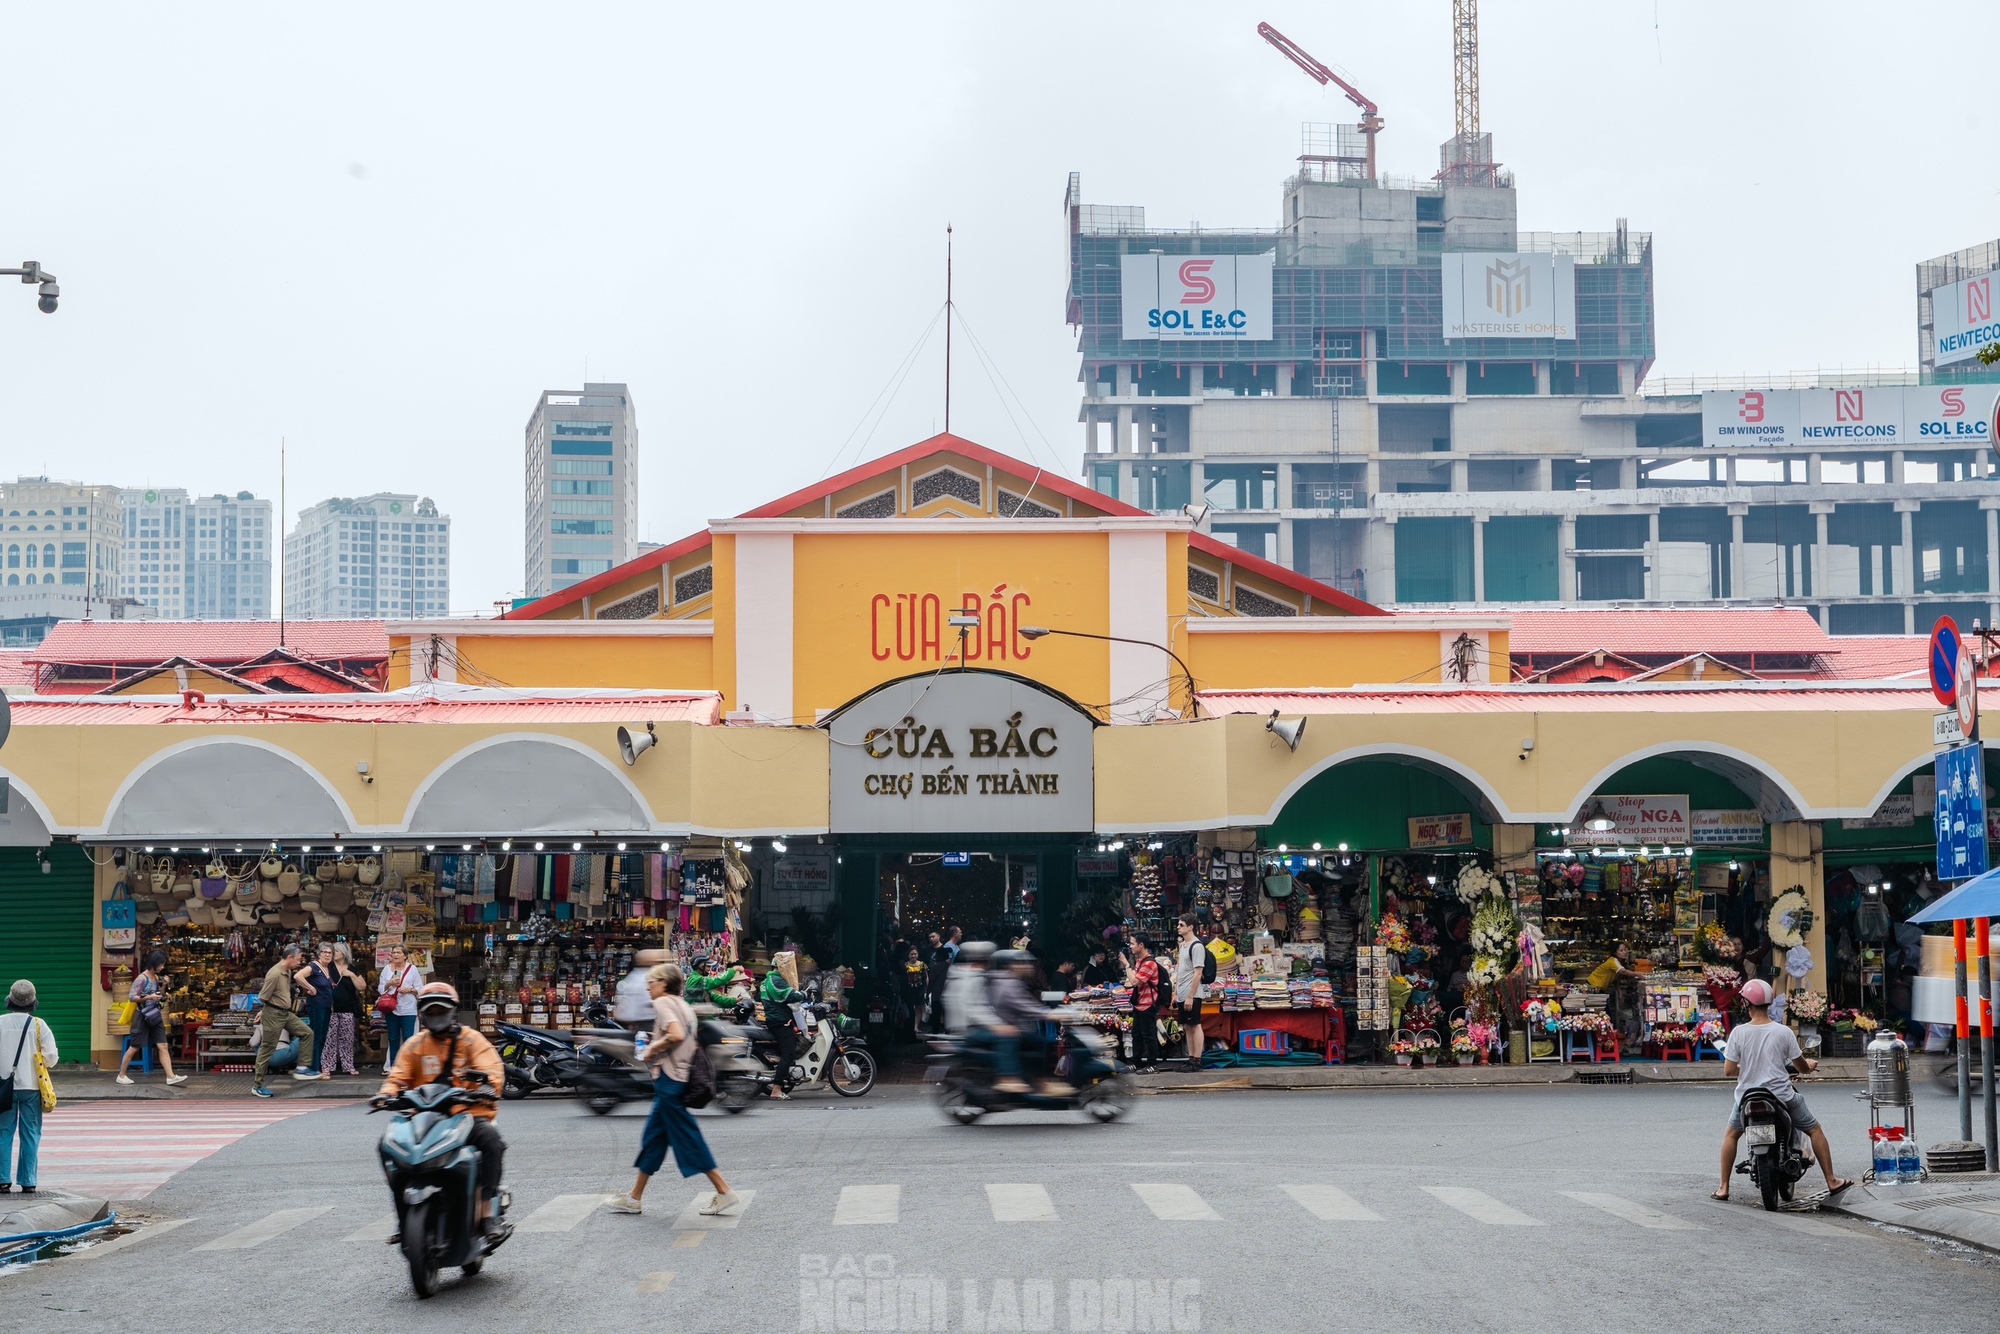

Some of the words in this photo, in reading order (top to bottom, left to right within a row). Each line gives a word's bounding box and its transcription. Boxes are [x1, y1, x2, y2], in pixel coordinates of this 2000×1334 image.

[1148, 308, 1194, 329] SOL
[1202, 309, 1247, 329] E&C
[1451, 323, 1520, 333] MASTERISE
[1524, 323, 1567, 335] HOMES
[1718, 426, 1735, 435] BM
[1737, 425, 1785, 435] WINDOWS
[1802, 424, 1896, 438] NEWTECONS
[1919, 421, 1952, 435] SOL
[1956, 421, 1988, 435] E&C
[864, 716, 954, 759] CỬA
[969, 711, 1059, 758] BẮC
[864, 772, 914, 800] CHỢ
[921, 765, 969, 795] BẾN
[975, 768, 1059, 795] THÀNH
[1617, 796, 1645, 809] Shop
[1640, 810, 1683, 823] NGA
[1623, 827, 1640, 836] CHỢ
[1641, 825, 1657, 834] BẾN
[1657, 826, 1685, 834] THÀNH
